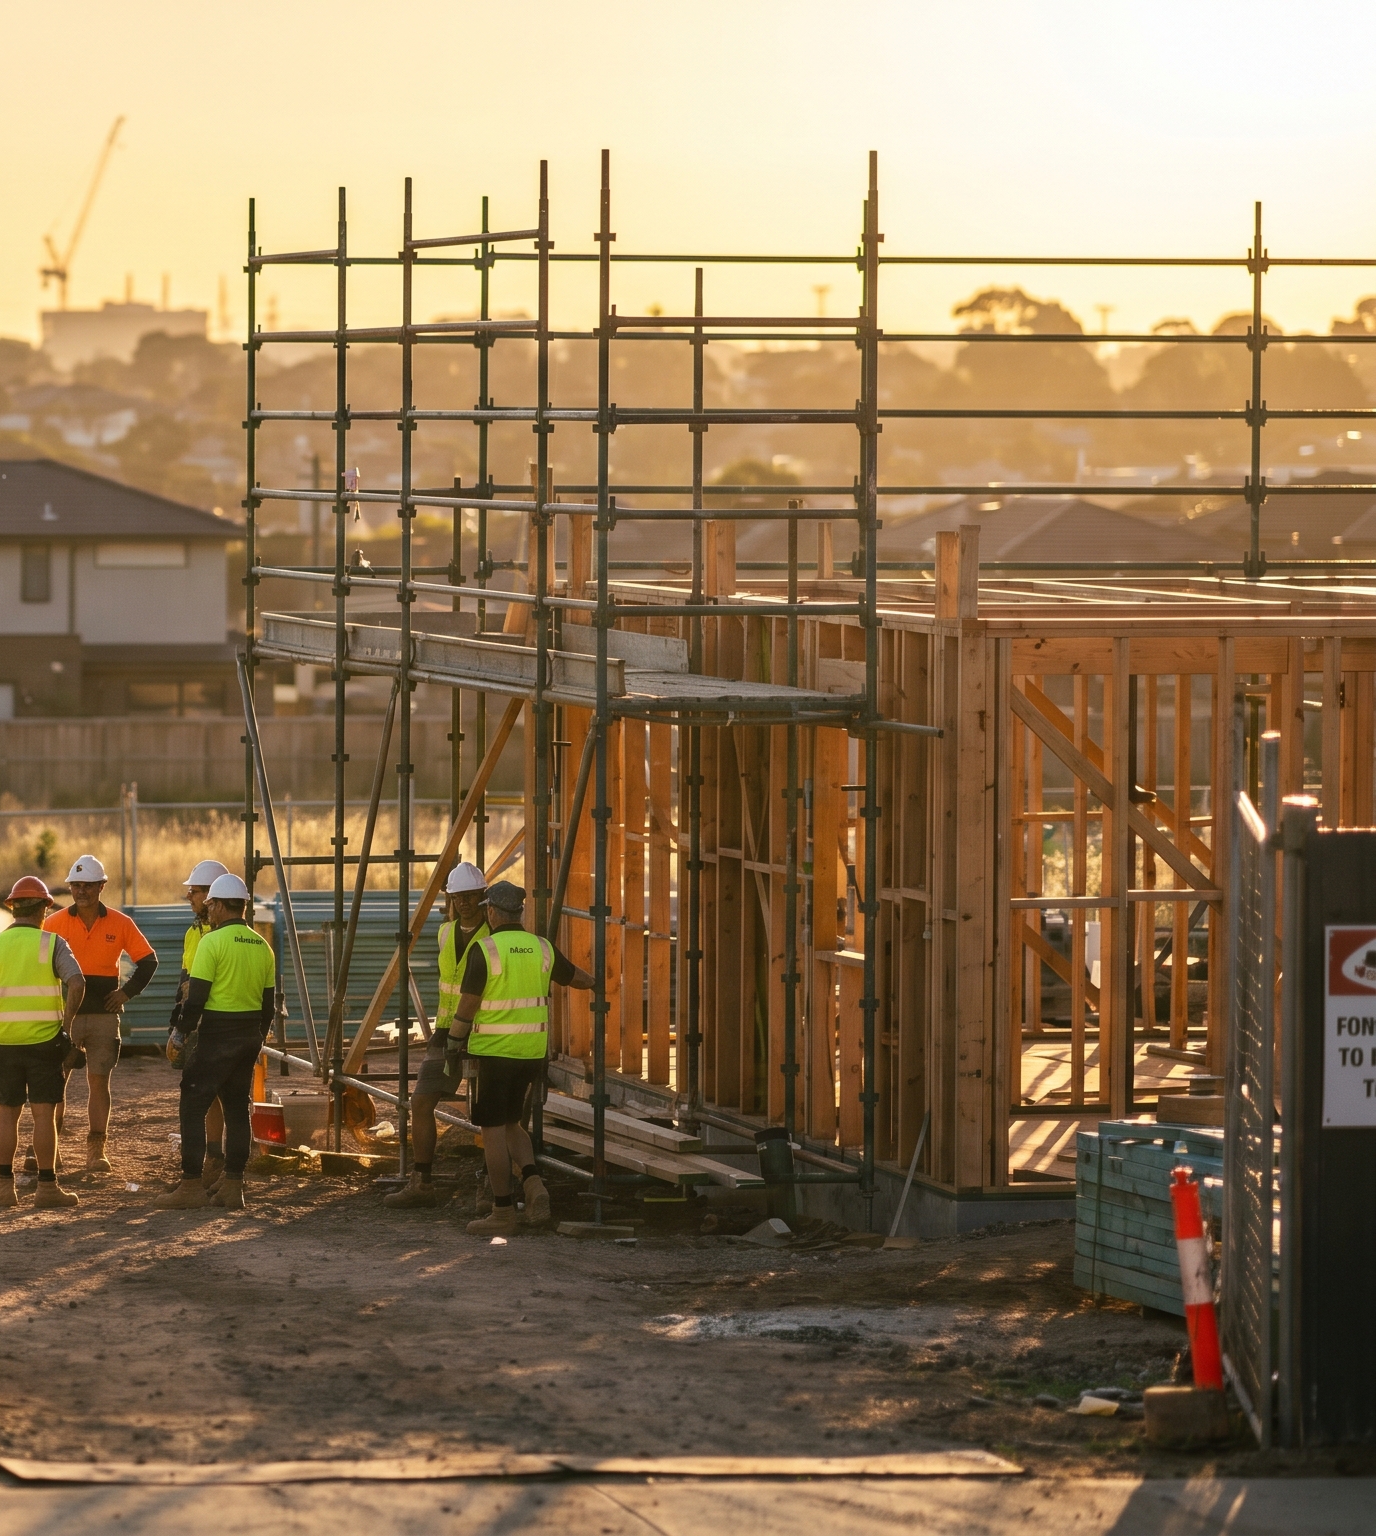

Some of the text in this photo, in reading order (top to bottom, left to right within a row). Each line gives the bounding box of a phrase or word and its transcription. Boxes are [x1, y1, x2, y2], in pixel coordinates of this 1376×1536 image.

[1336, 1016, 1376, 1037] FON
[1338, 1047, 1364, 1068] TO
[1363, 1079, 1376, 1098] T
